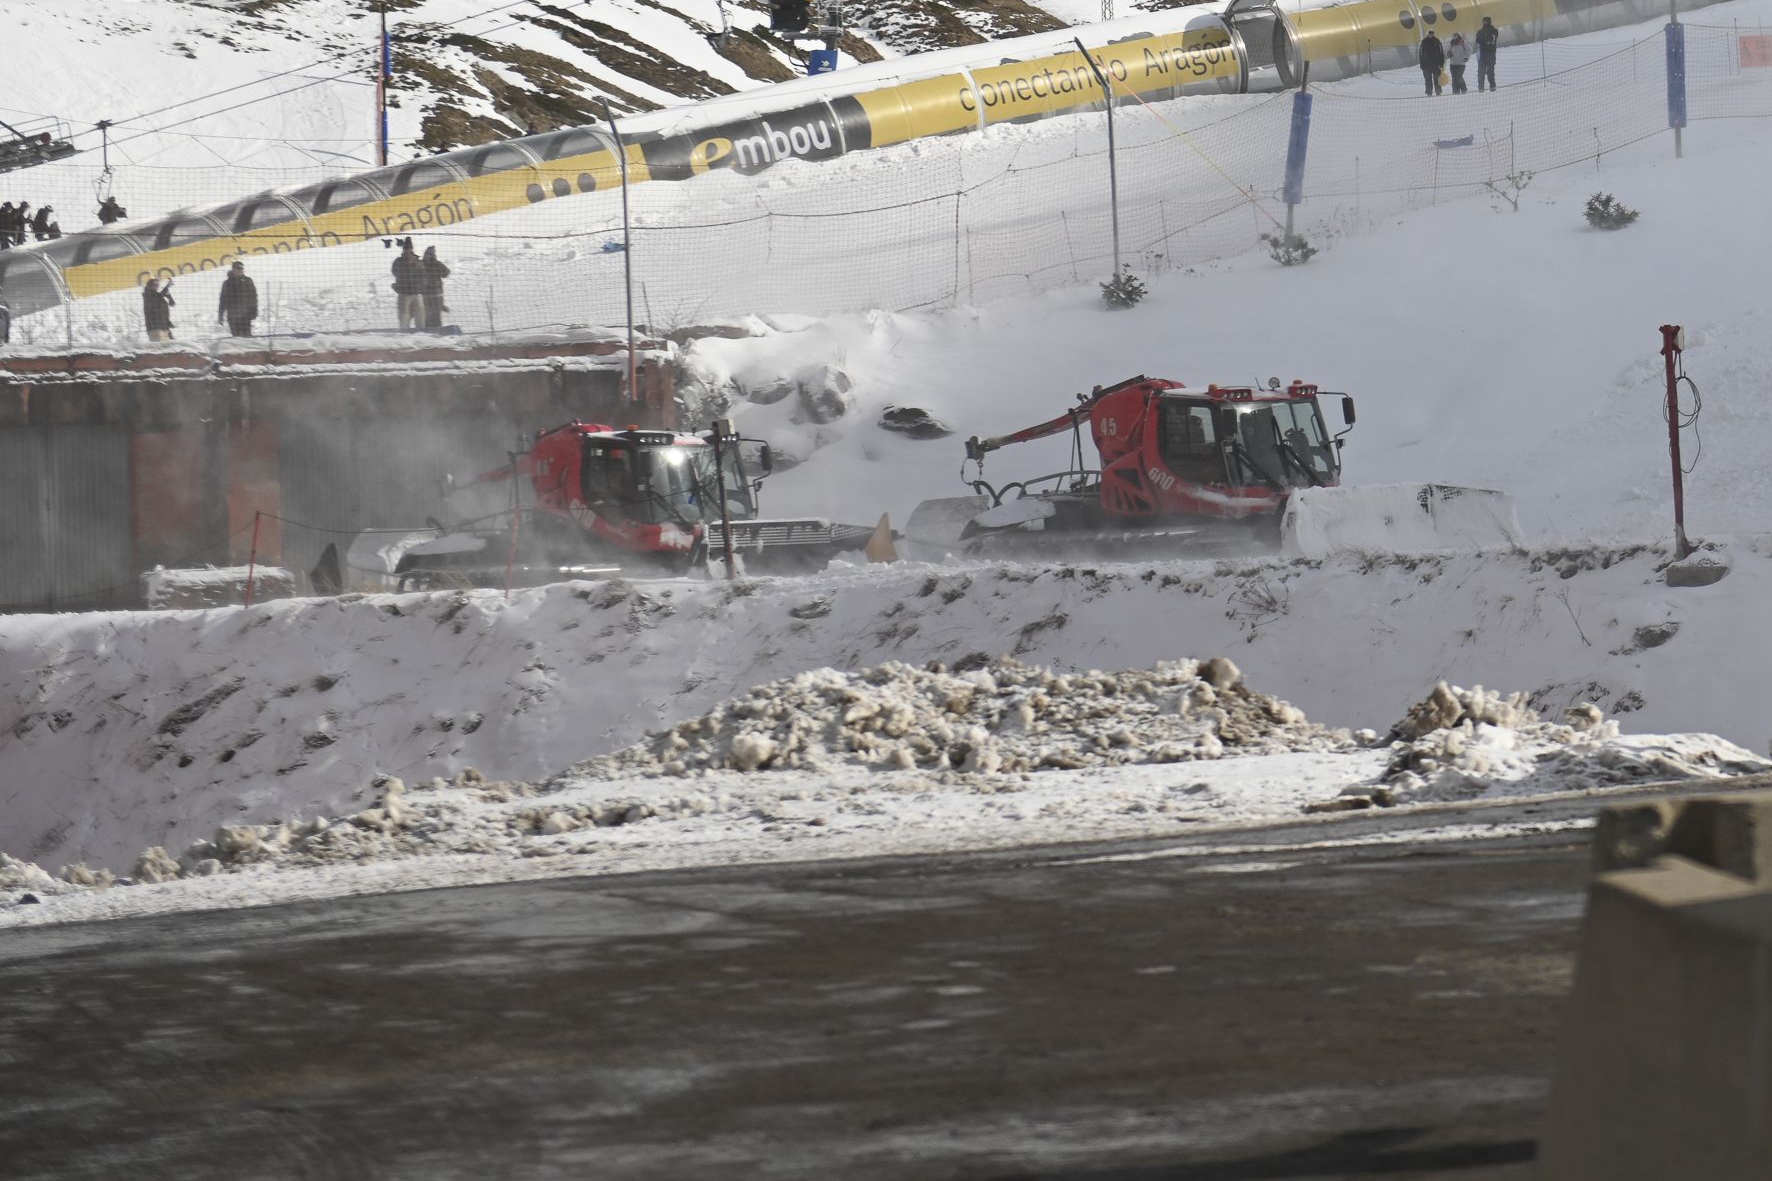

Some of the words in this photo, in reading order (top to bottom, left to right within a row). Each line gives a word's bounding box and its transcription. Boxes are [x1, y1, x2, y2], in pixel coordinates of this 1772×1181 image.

[959, 55, 1128, 112] conectando
[1142, 32, 1236, 77] Aragón
[690, 120, 832, 176] embou
[362, 193, 474, 240] Aragón
